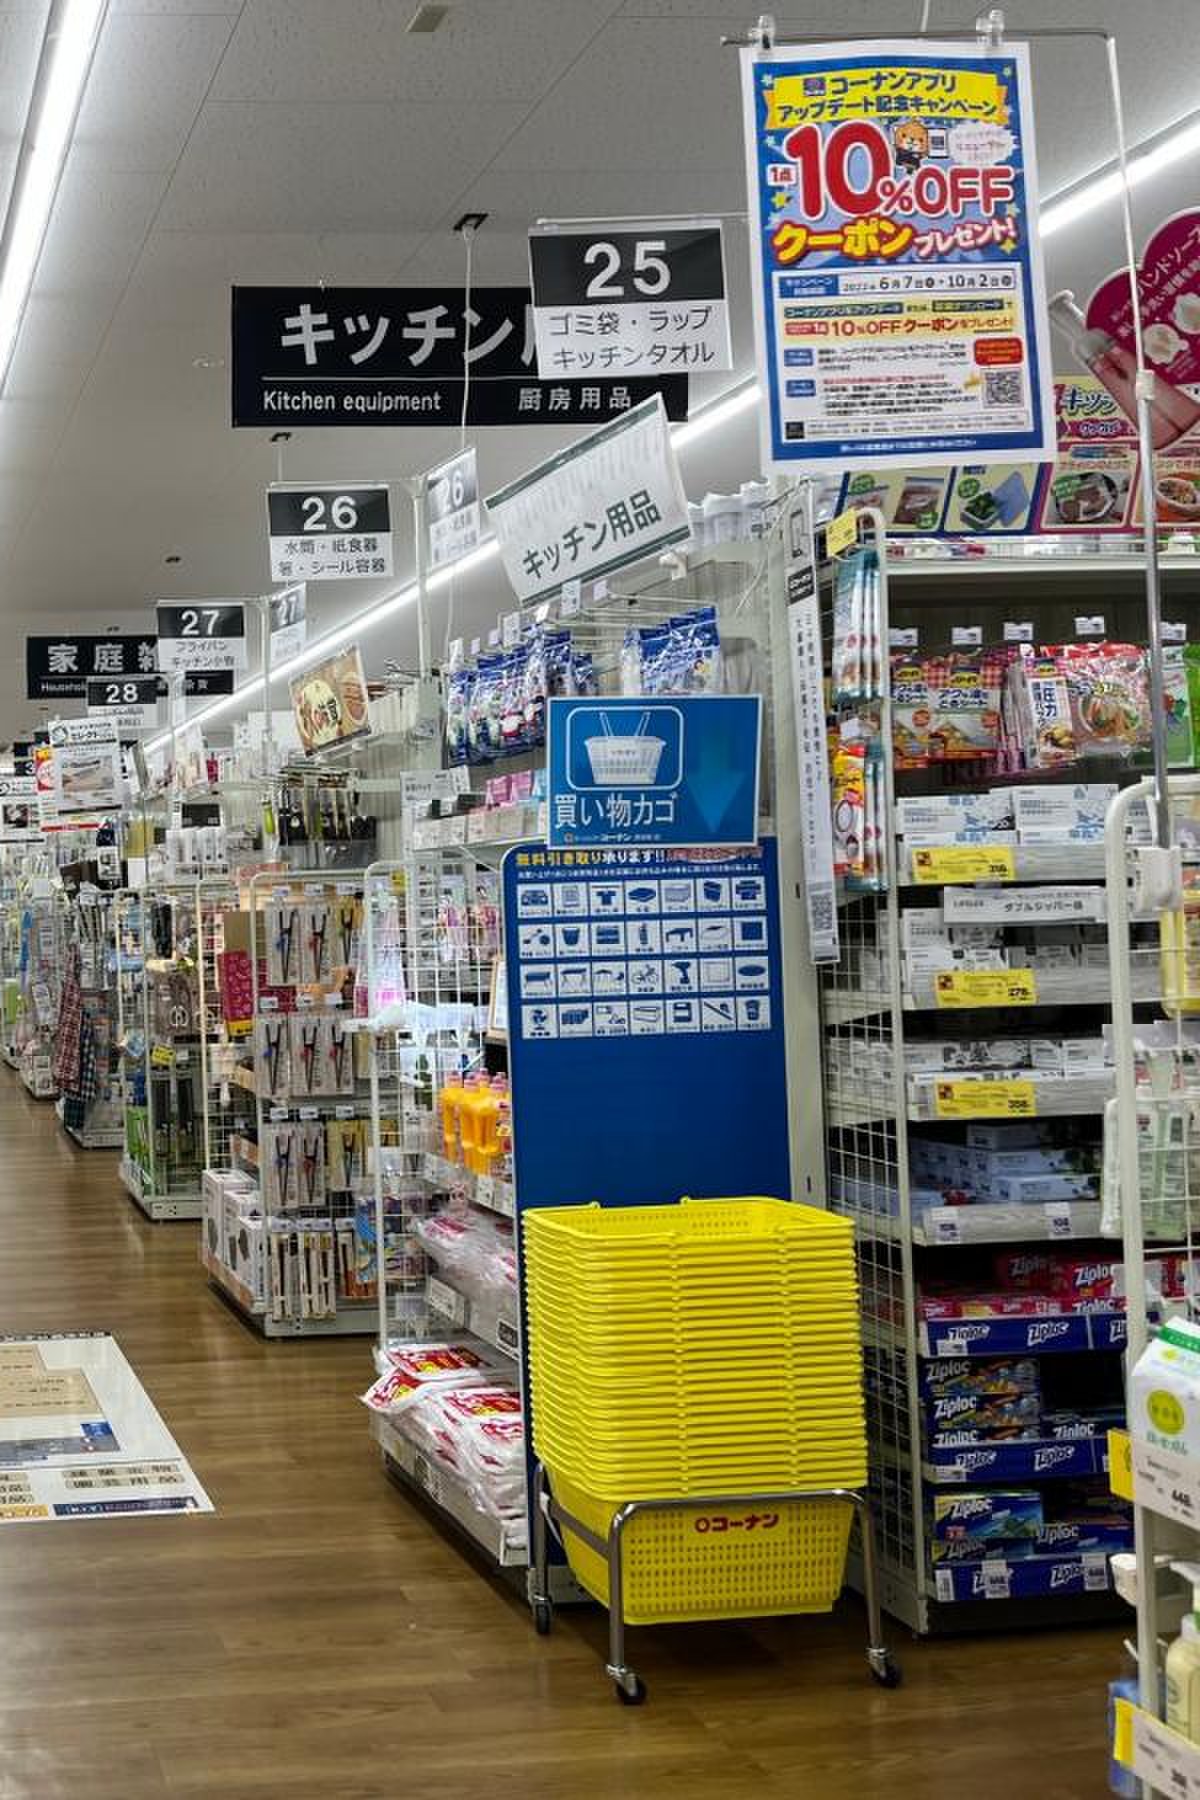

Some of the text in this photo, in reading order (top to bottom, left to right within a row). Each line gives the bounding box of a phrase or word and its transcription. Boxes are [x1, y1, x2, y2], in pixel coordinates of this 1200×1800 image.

[832, 72, 957, 95] コーナンアプリ
[584, 241, 672, 298] 25
[549, 306, 712, 336] ゴミ袋・ラップ
[281, 303, 536, 367] キッチン
[553, 341, 714, 370] キッチンタオル
[264, 390, 442, 413] Kitchen equipment
[518, 386, 632, 411] 厨房用品
[301, 496, 358, 531] 26
[522, 489, 662, 581] キッチン用品
[181, 609, 220, 636] 27
[106, 683, 139, 704] 28
[555, 792, 679, 829] 買い物カゴ
[934, 1396, 977, 1418] Ziploc
[952, 1498, 993, 1519] Ziploc
[1051, 1563, 1083, 1588] Ziplo
